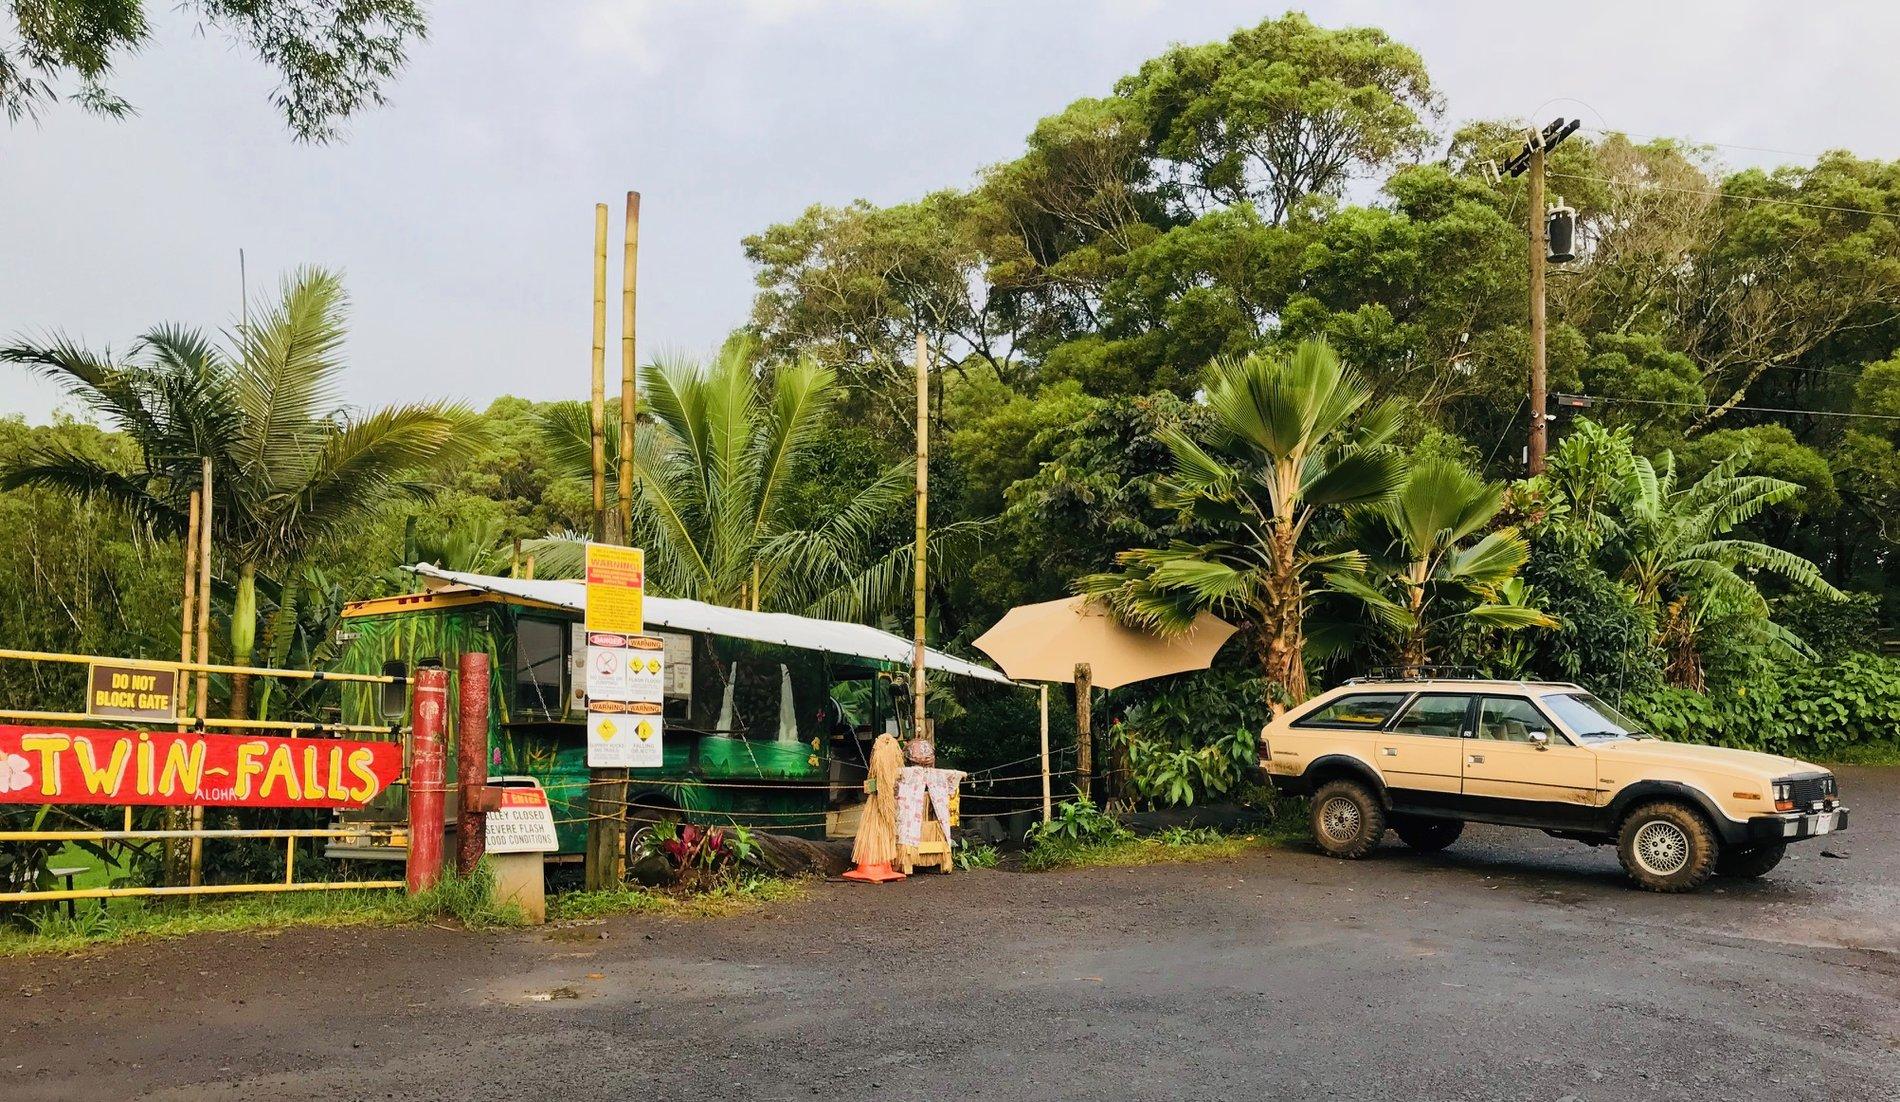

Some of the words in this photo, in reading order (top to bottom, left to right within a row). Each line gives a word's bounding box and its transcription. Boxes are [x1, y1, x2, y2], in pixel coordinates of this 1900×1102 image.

[591, 558, 639, 571] WARNING!
[631, 640, 662, 648] WARNING
[112, 673, 128, 690] DO
[132, 675, 156, 691] NOT
[96, 691, 135, 708] BLOCK
[138, 693, 168, 710] GATE
[592, 703, 624, 711] WARNING
[235, 740, 379, 804] FALLS
[194, 787, 237, 800] ALOHA
[511, 793, 541, 804] ENTER
[486, 811, 508, 820] ALLEY
[513, 811, 544, 820] CLOSED
[486, 824, 517, 835] SEVERE
[520, 824, 544, 834] FLASH
[486, 835, 506, 845] LOOD
[509, 834, 552, 845] CONDITIONS
